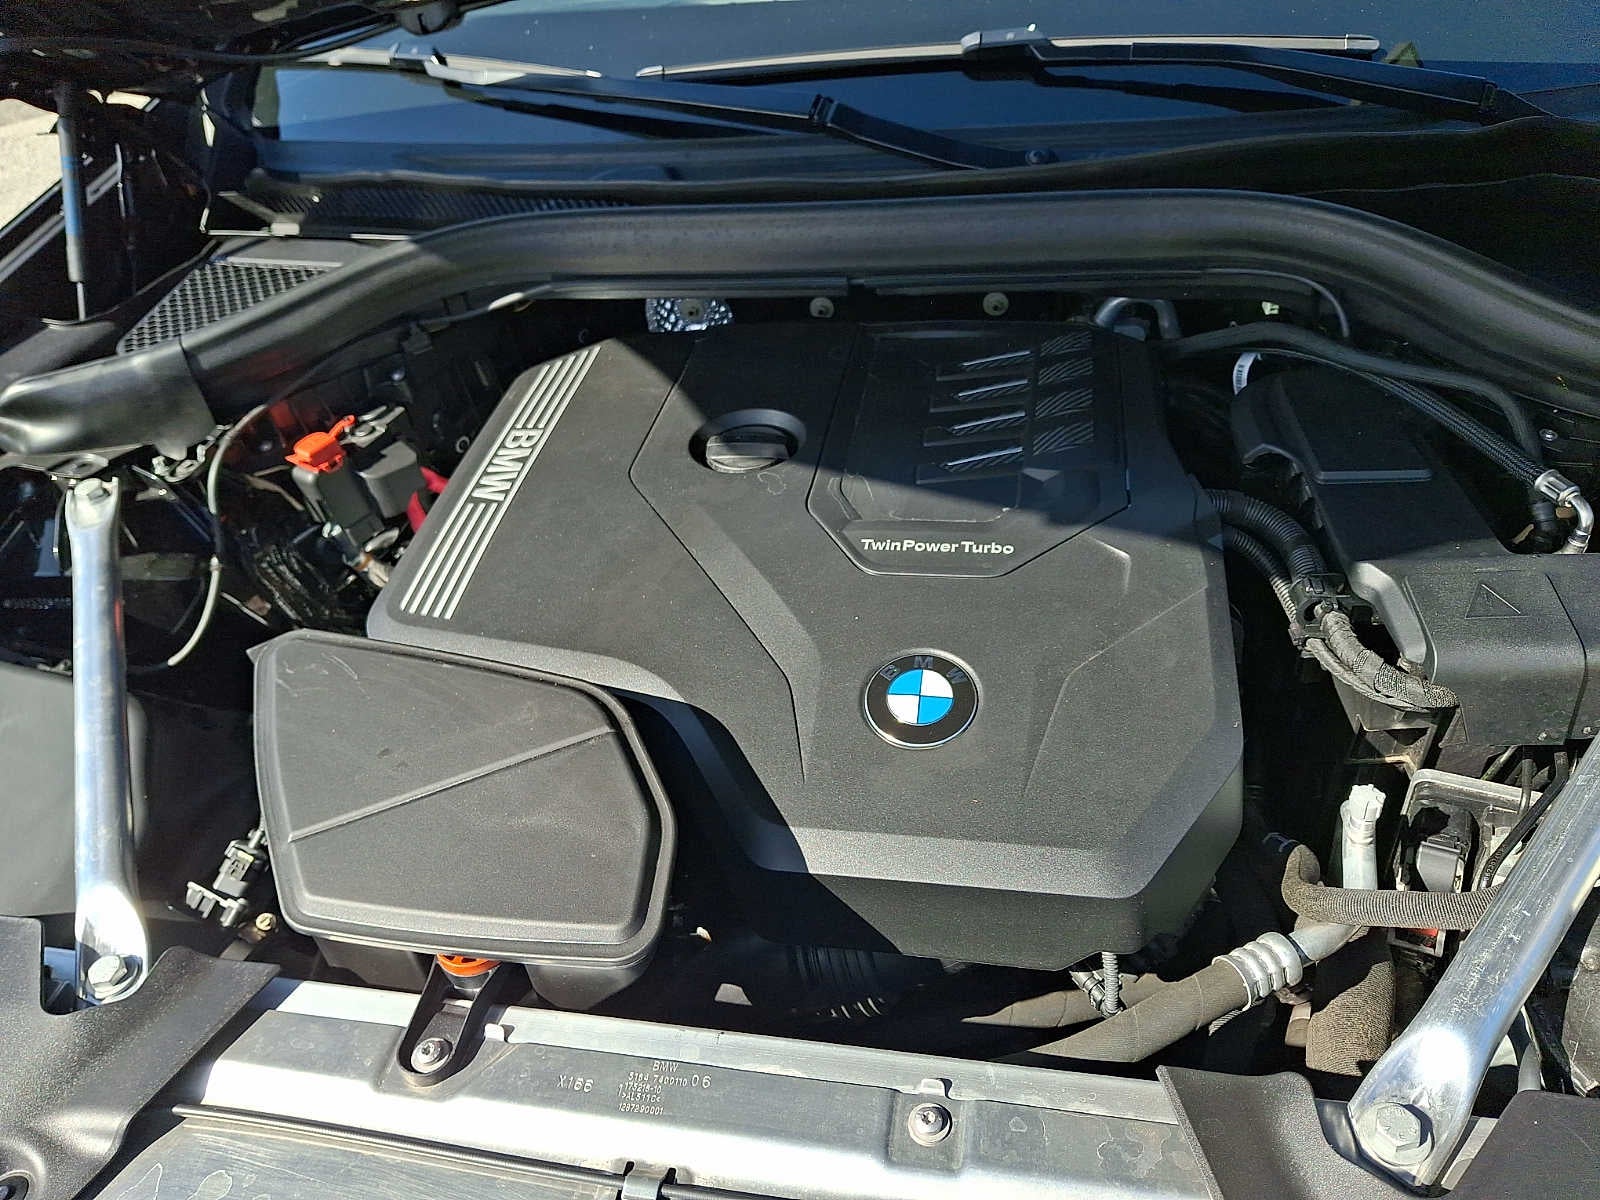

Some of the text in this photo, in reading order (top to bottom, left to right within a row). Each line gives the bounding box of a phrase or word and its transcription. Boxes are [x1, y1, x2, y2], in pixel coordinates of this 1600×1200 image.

[471, 427, 544, 501] BMW
[860, 538, 1015, 555] TwinPower Turbo
[879, 655, 968, 684] BMW
[652, 1060, 679, 1072] BMW
